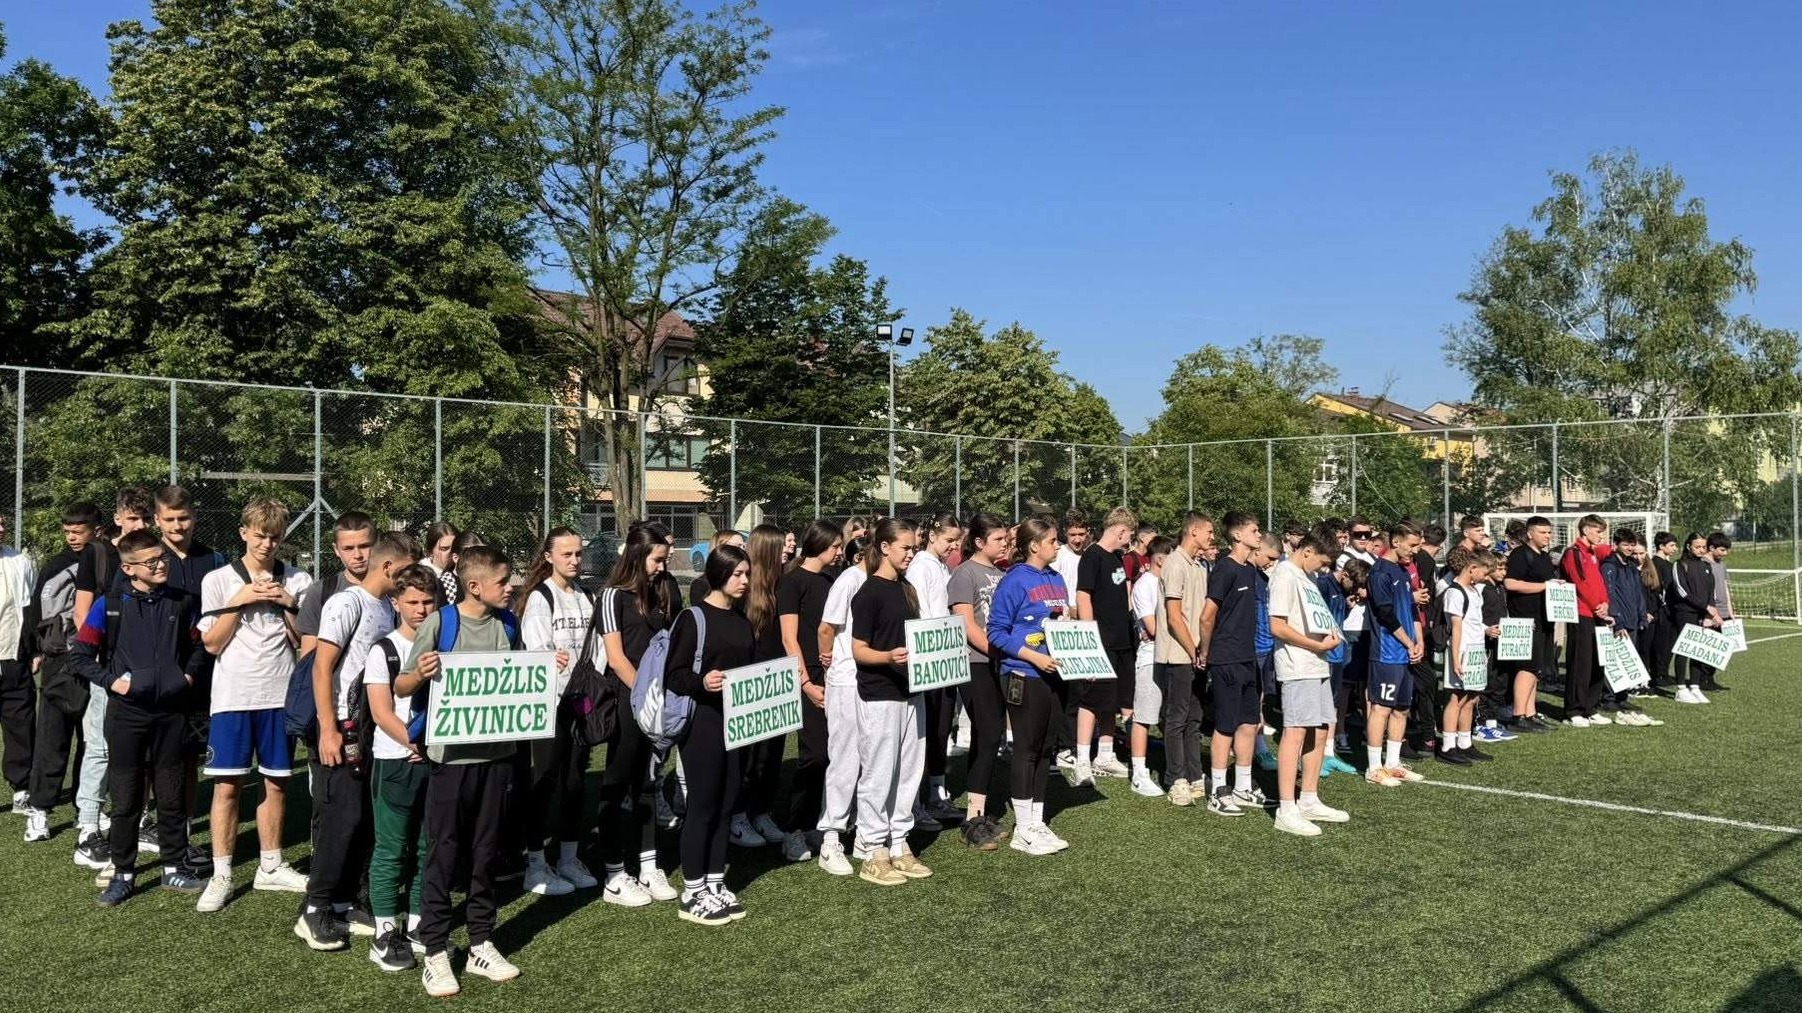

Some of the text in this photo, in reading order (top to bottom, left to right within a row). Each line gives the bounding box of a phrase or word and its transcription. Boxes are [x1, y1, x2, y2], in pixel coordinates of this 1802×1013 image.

[913, 621, 964, 654] MEDŽLIS
[1050, 625, 1098, 650] MEDŽLIS
[1502, 621, 1531, 639] MEDŽLIS
[1684, 629, 1730, 653] MEDŽLIS
[912, 649, 968, 686] BANOVIĆI
[1677, 641, 1726, 666] KLADANJ
[443, 657, 548, 696] MEDŽLIS
[730, 667, 794, 707] MEDŽLIS
[1380, 682, 1396, 701] 12
[434, 699, 548, 737] ŽIVINICE
[727, 700, 800, 742] SREBRENIK
